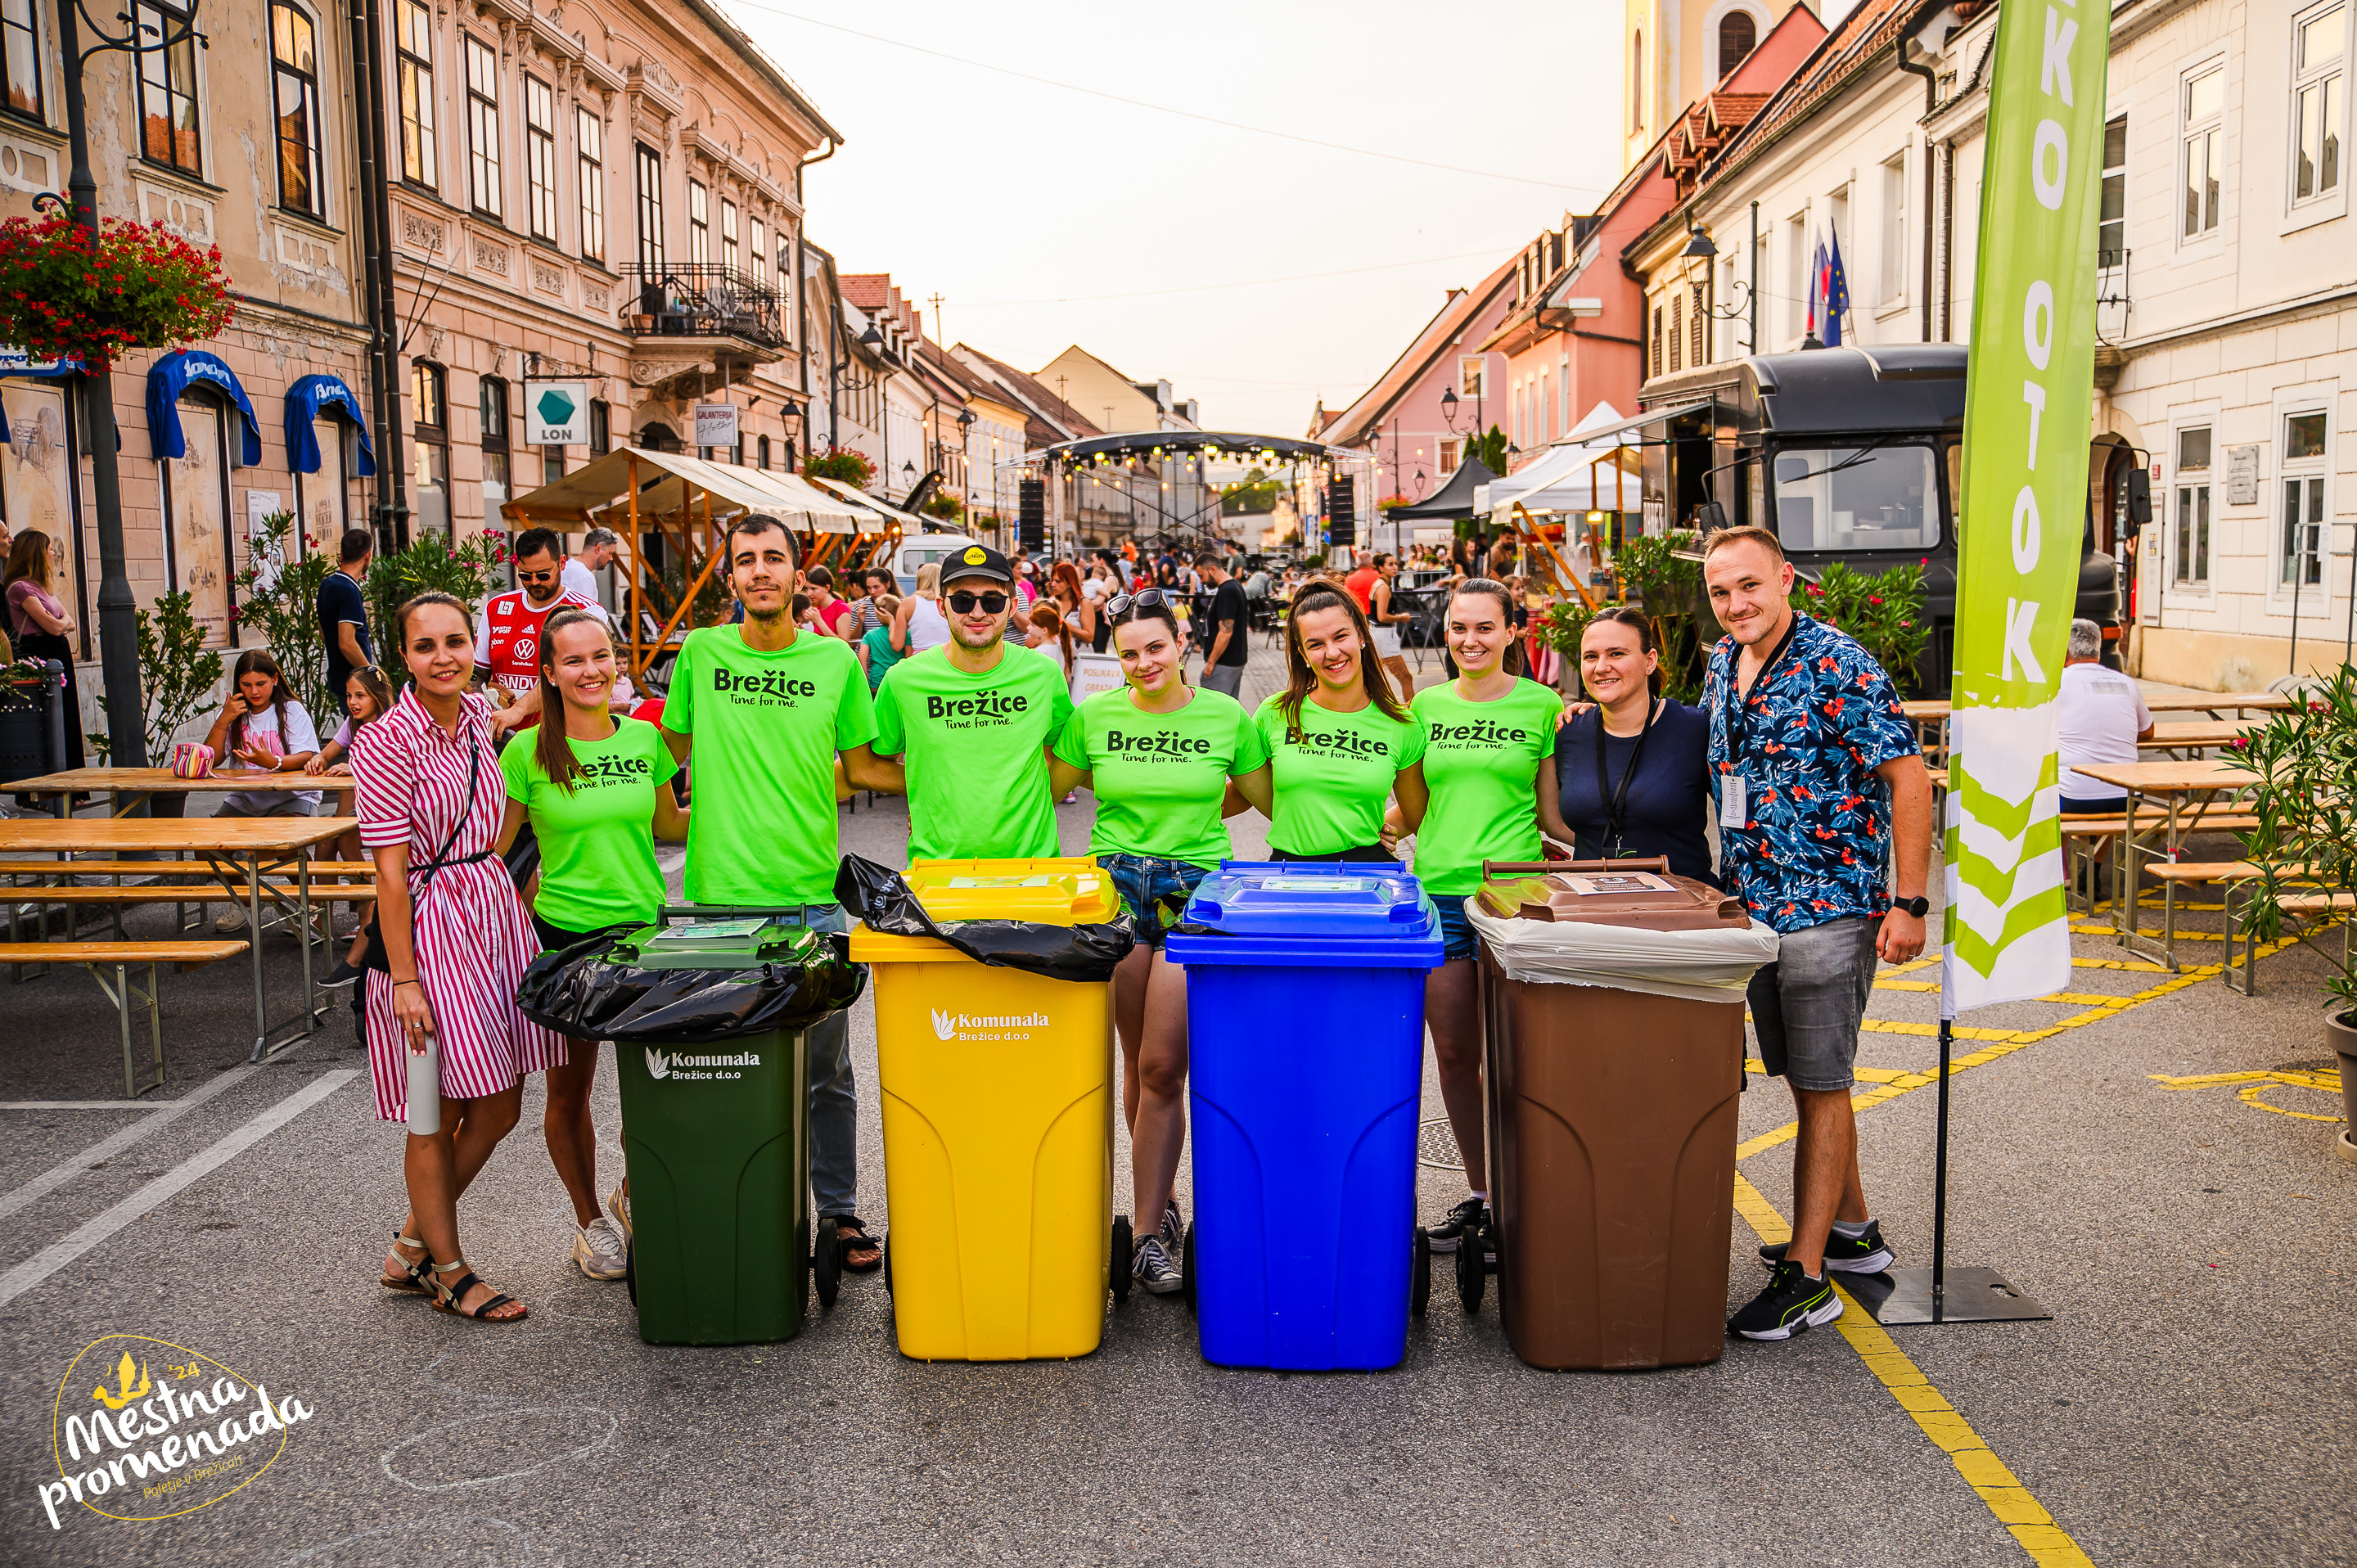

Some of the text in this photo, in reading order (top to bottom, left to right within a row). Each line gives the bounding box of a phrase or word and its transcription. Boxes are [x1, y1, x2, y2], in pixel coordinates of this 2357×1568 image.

[2031, 0, 2079, 211] KO
[542, 430, 572, 440] LON
[2002, 280, 2053, 684] OTOK
[1084, 668, 1120, 678] POSLIKAVA
[714, 668, 815, 700] Brežice
[730, 694, 755, 705] Time
[759, 695, 774, 706] for
[927, 690, 1028, 719] Brežice
[944, 717, 1013, 729] Time for me.
[1430, 719, 1526, 743] Brežice
[1107, 730, 1210, 757] Brežice
[1284, 727, 1389, 755] Brežice
[1437, 741, 1462, 750] Time
[1466, 741, 1481, 750] for
[1121, 753, 1147, 763] Time
[1151, 753, 1167, 764] for
[1298, 746, 1326, 756] Time
[1330, 749, 1346, 759] for
[602, 777, 617, 788] for
[620, 777, 641, 785] me.
[958, 1012, 1049, 1028] Komunala
[958, 1031, 1030, 1041] Brežice d.o.o
[672, 1052, 760, 1066] Komunala
[672, 1070, 741, 1079] Brežice d.o.o
